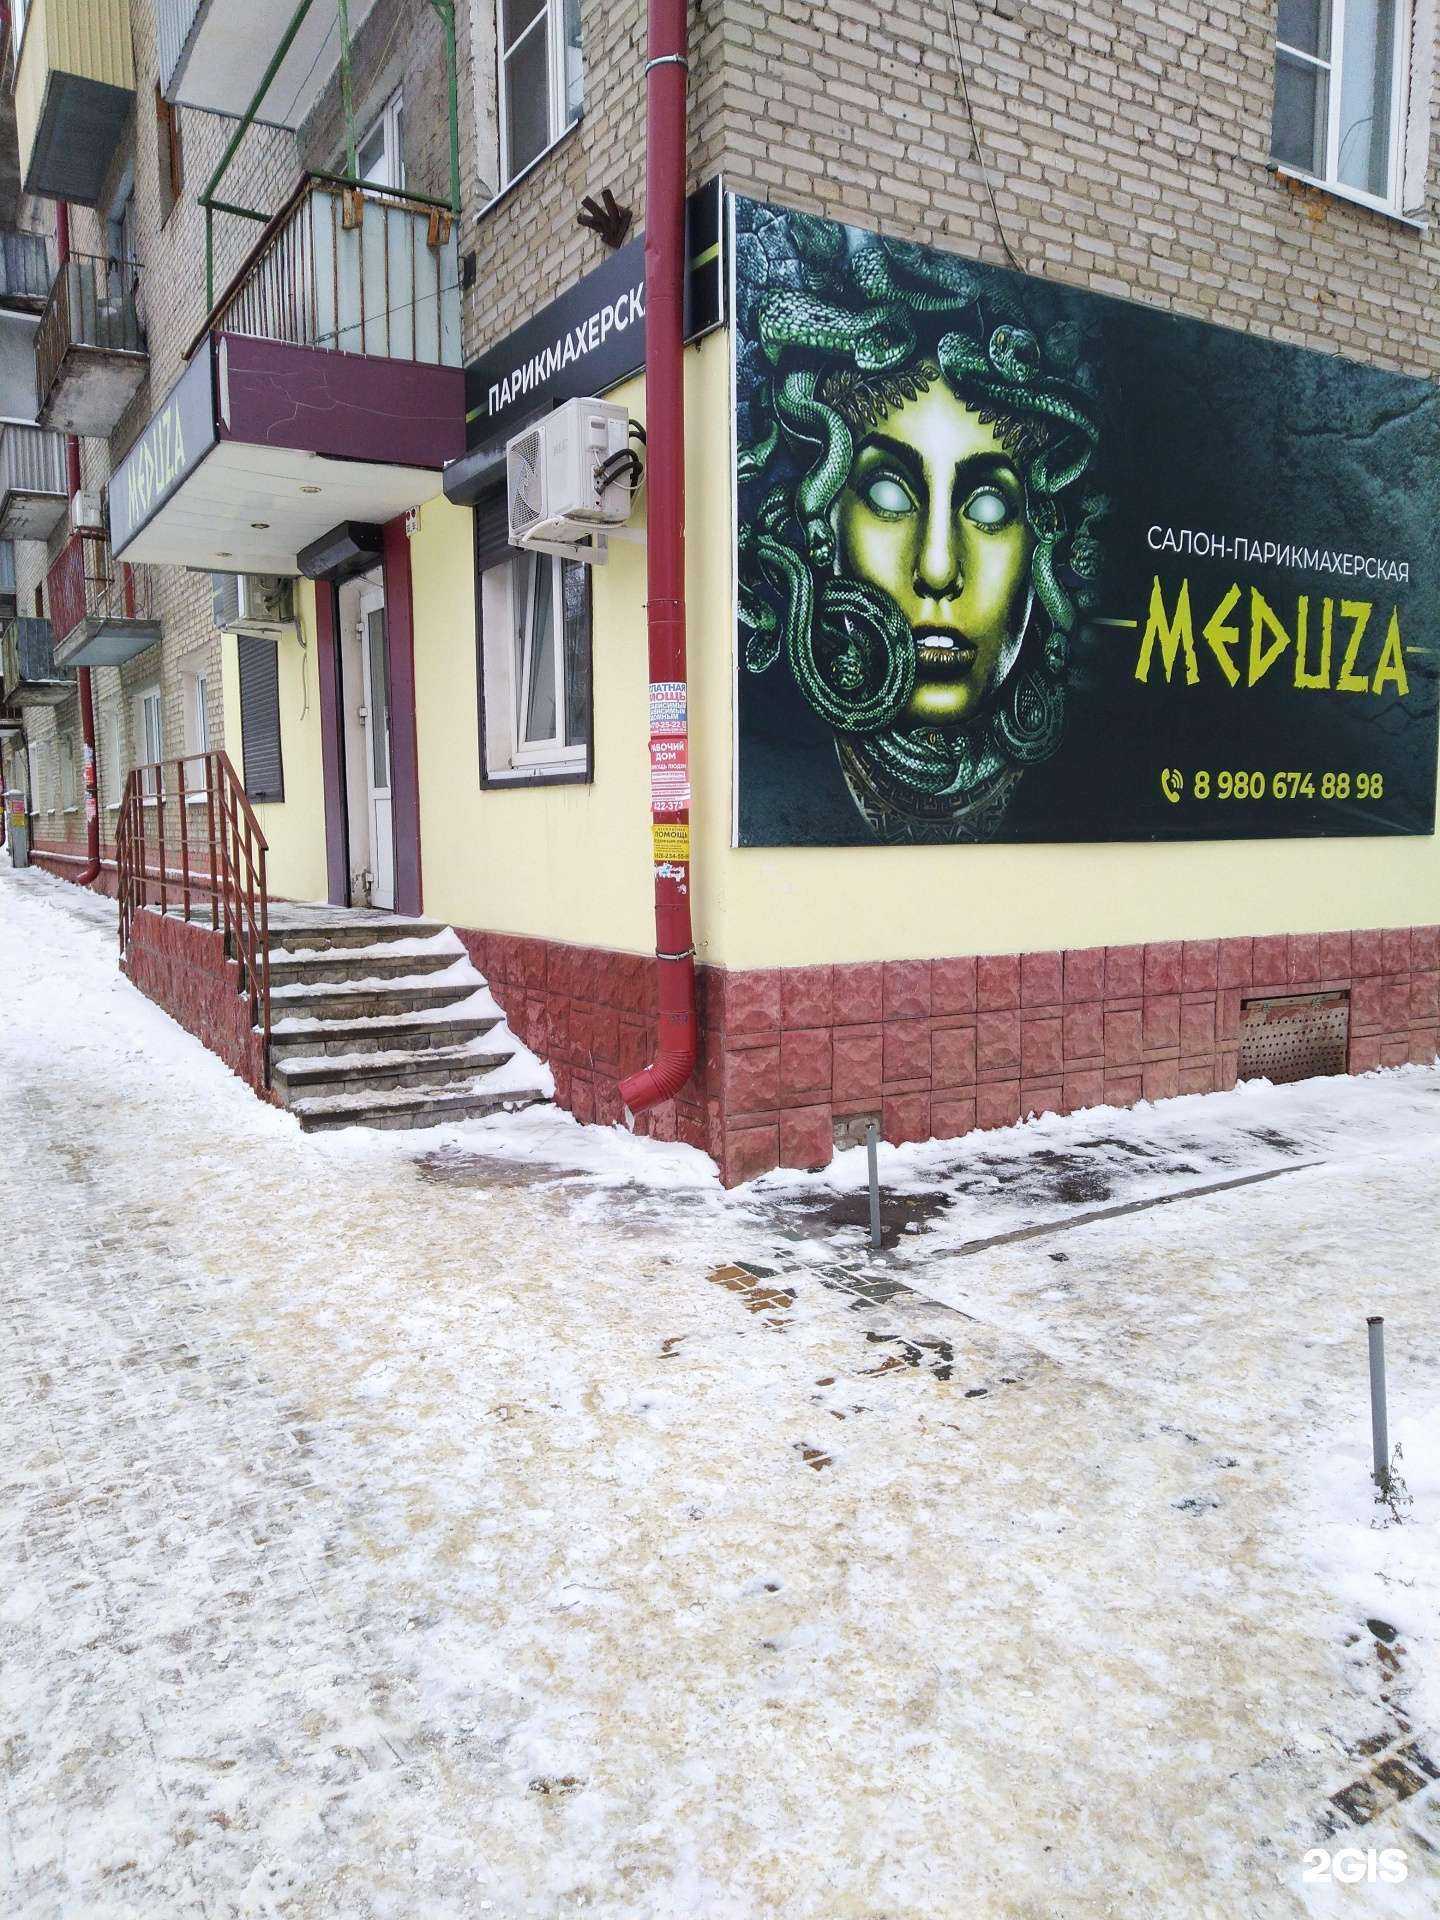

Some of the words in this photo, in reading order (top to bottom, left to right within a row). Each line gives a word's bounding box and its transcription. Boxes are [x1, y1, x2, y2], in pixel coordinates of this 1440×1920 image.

[488, 281, 646, 417] ПАРИКМАХЕРСК
[127, 395, 186, 530] MEDUZA
[1147, 525, 1410, 583] САЛОН-ПАРИКМАХЕРСКАЯ
[1135, 574, 1410, 696] MEDUZA
[656, 752, 676, 761] ДОМ
[1194, 771, 1210, 798] 8
[1217, 771, 1265, 799] 980
[1272, 772, 1315, 798] 674
[1321, 772, 1350, 798] 88
[1356, 773, 1383, 799] 98
